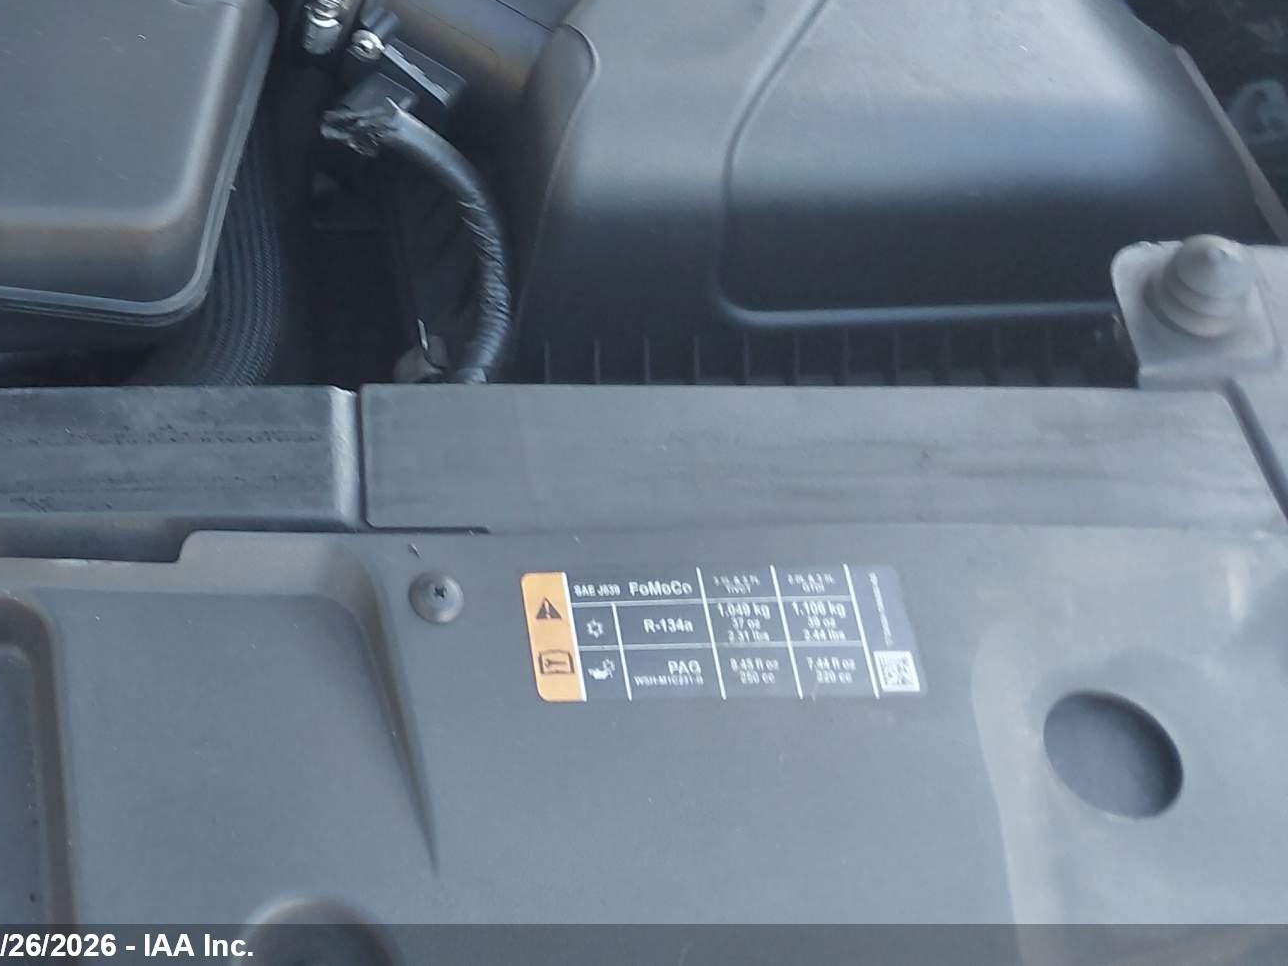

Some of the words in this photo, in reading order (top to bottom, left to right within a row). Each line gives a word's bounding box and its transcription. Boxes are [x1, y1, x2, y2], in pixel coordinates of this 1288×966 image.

[573, 584, 596, 596] SAE
[628, 580, 693, 596] FoMoCo
[753, 602, 771, 619] kg
[828, 601, 846, 618] kg
[643, 618, 694, 633] R-134a
